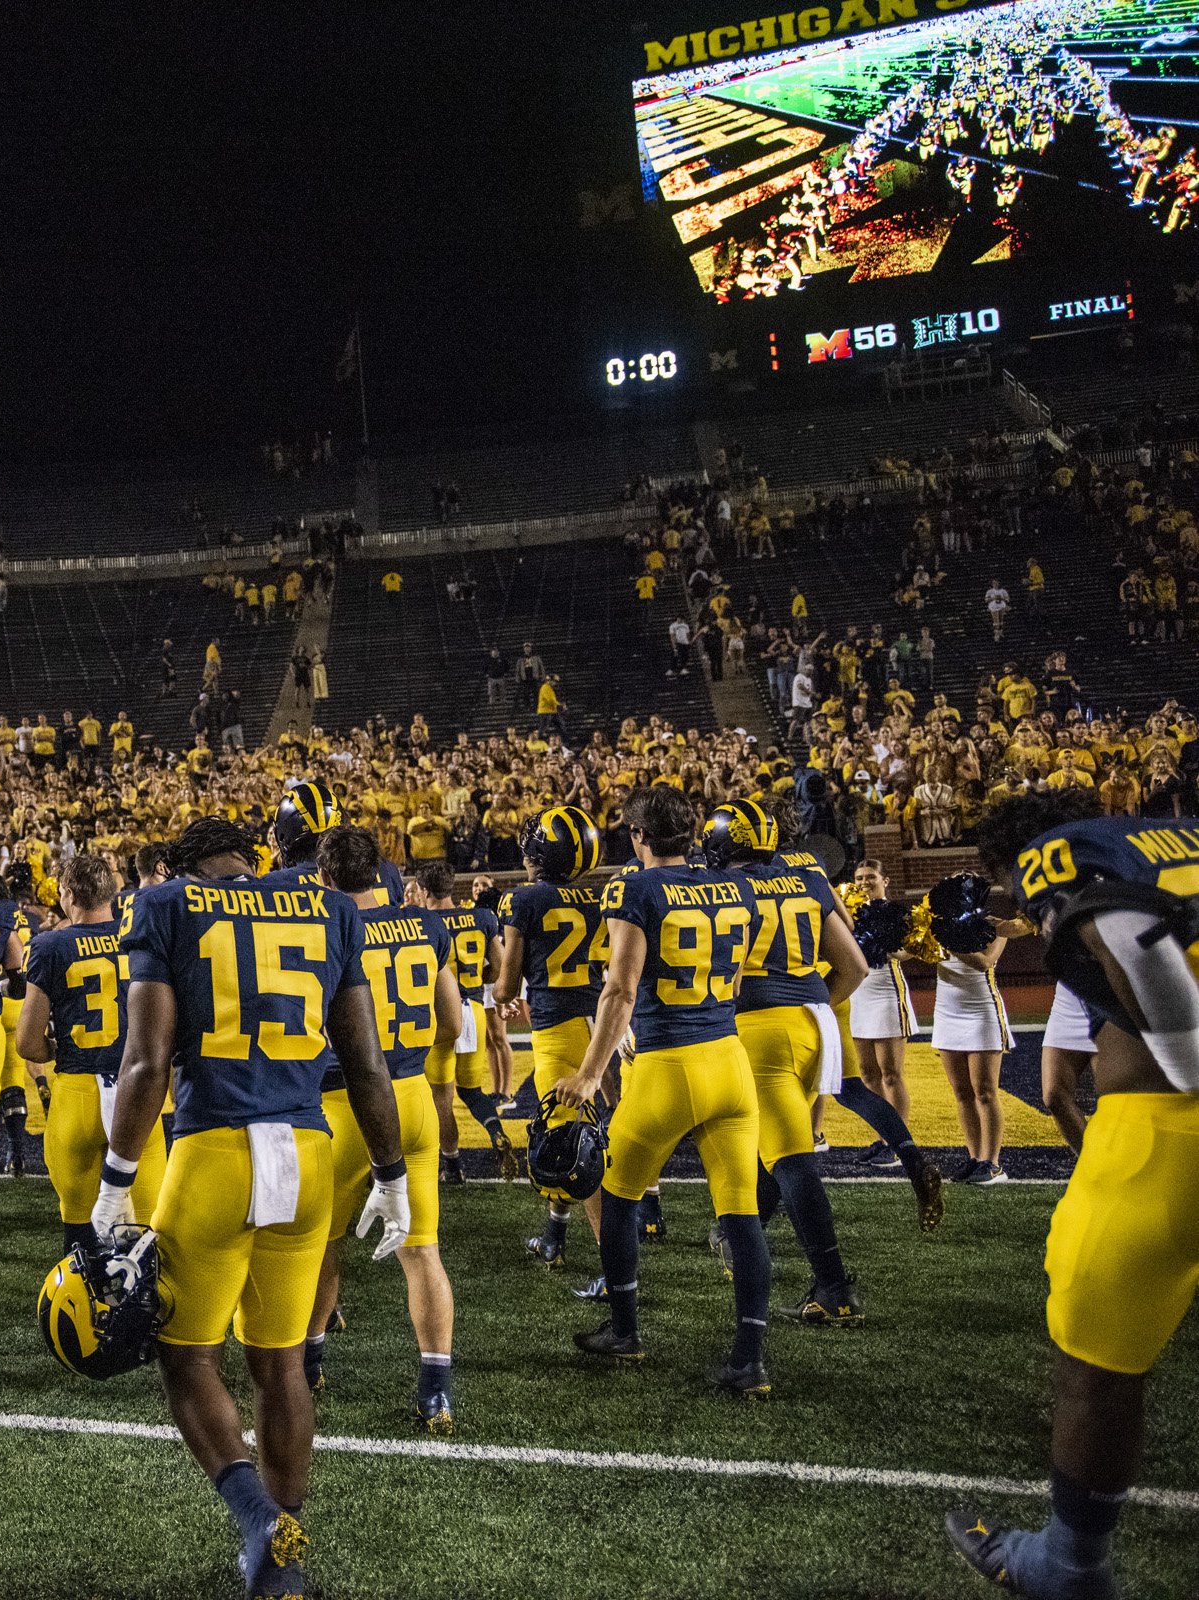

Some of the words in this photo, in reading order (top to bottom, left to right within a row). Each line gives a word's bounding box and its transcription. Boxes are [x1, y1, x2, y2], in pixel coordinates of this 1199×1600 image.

[645, 0, 918, 71] MICHIGAN
[1049, 295, 1126, 321] FINAL
[805, 328, 853, 363] M
[855, 323, 897, 351] 56
[912, 311, 959, 350] H
[960, 308, 1000, 336] 10
[605, 350, 677, 386] 0:00
[780, 852, 817, 867] DOMAN
[1017, 838, 1077, 899] 20
[557, 887, 600, 904] BYLE
[662, 882, 743, 906] MENTZER
[747, 876, 807, 895] MMONS
[185, 884, 330, 918] SPURLOCK
[364, 917, 429, 945] NOHUE
[442, 914, 475, 930] YLOR
[75, 934, 120, 957] HUGH
[743, 897, 822, 978] 70
[656, 906, 751, 1006] 93
[199, 920, 327, 1061] 15
[645, 1224, 658, 1233] M
